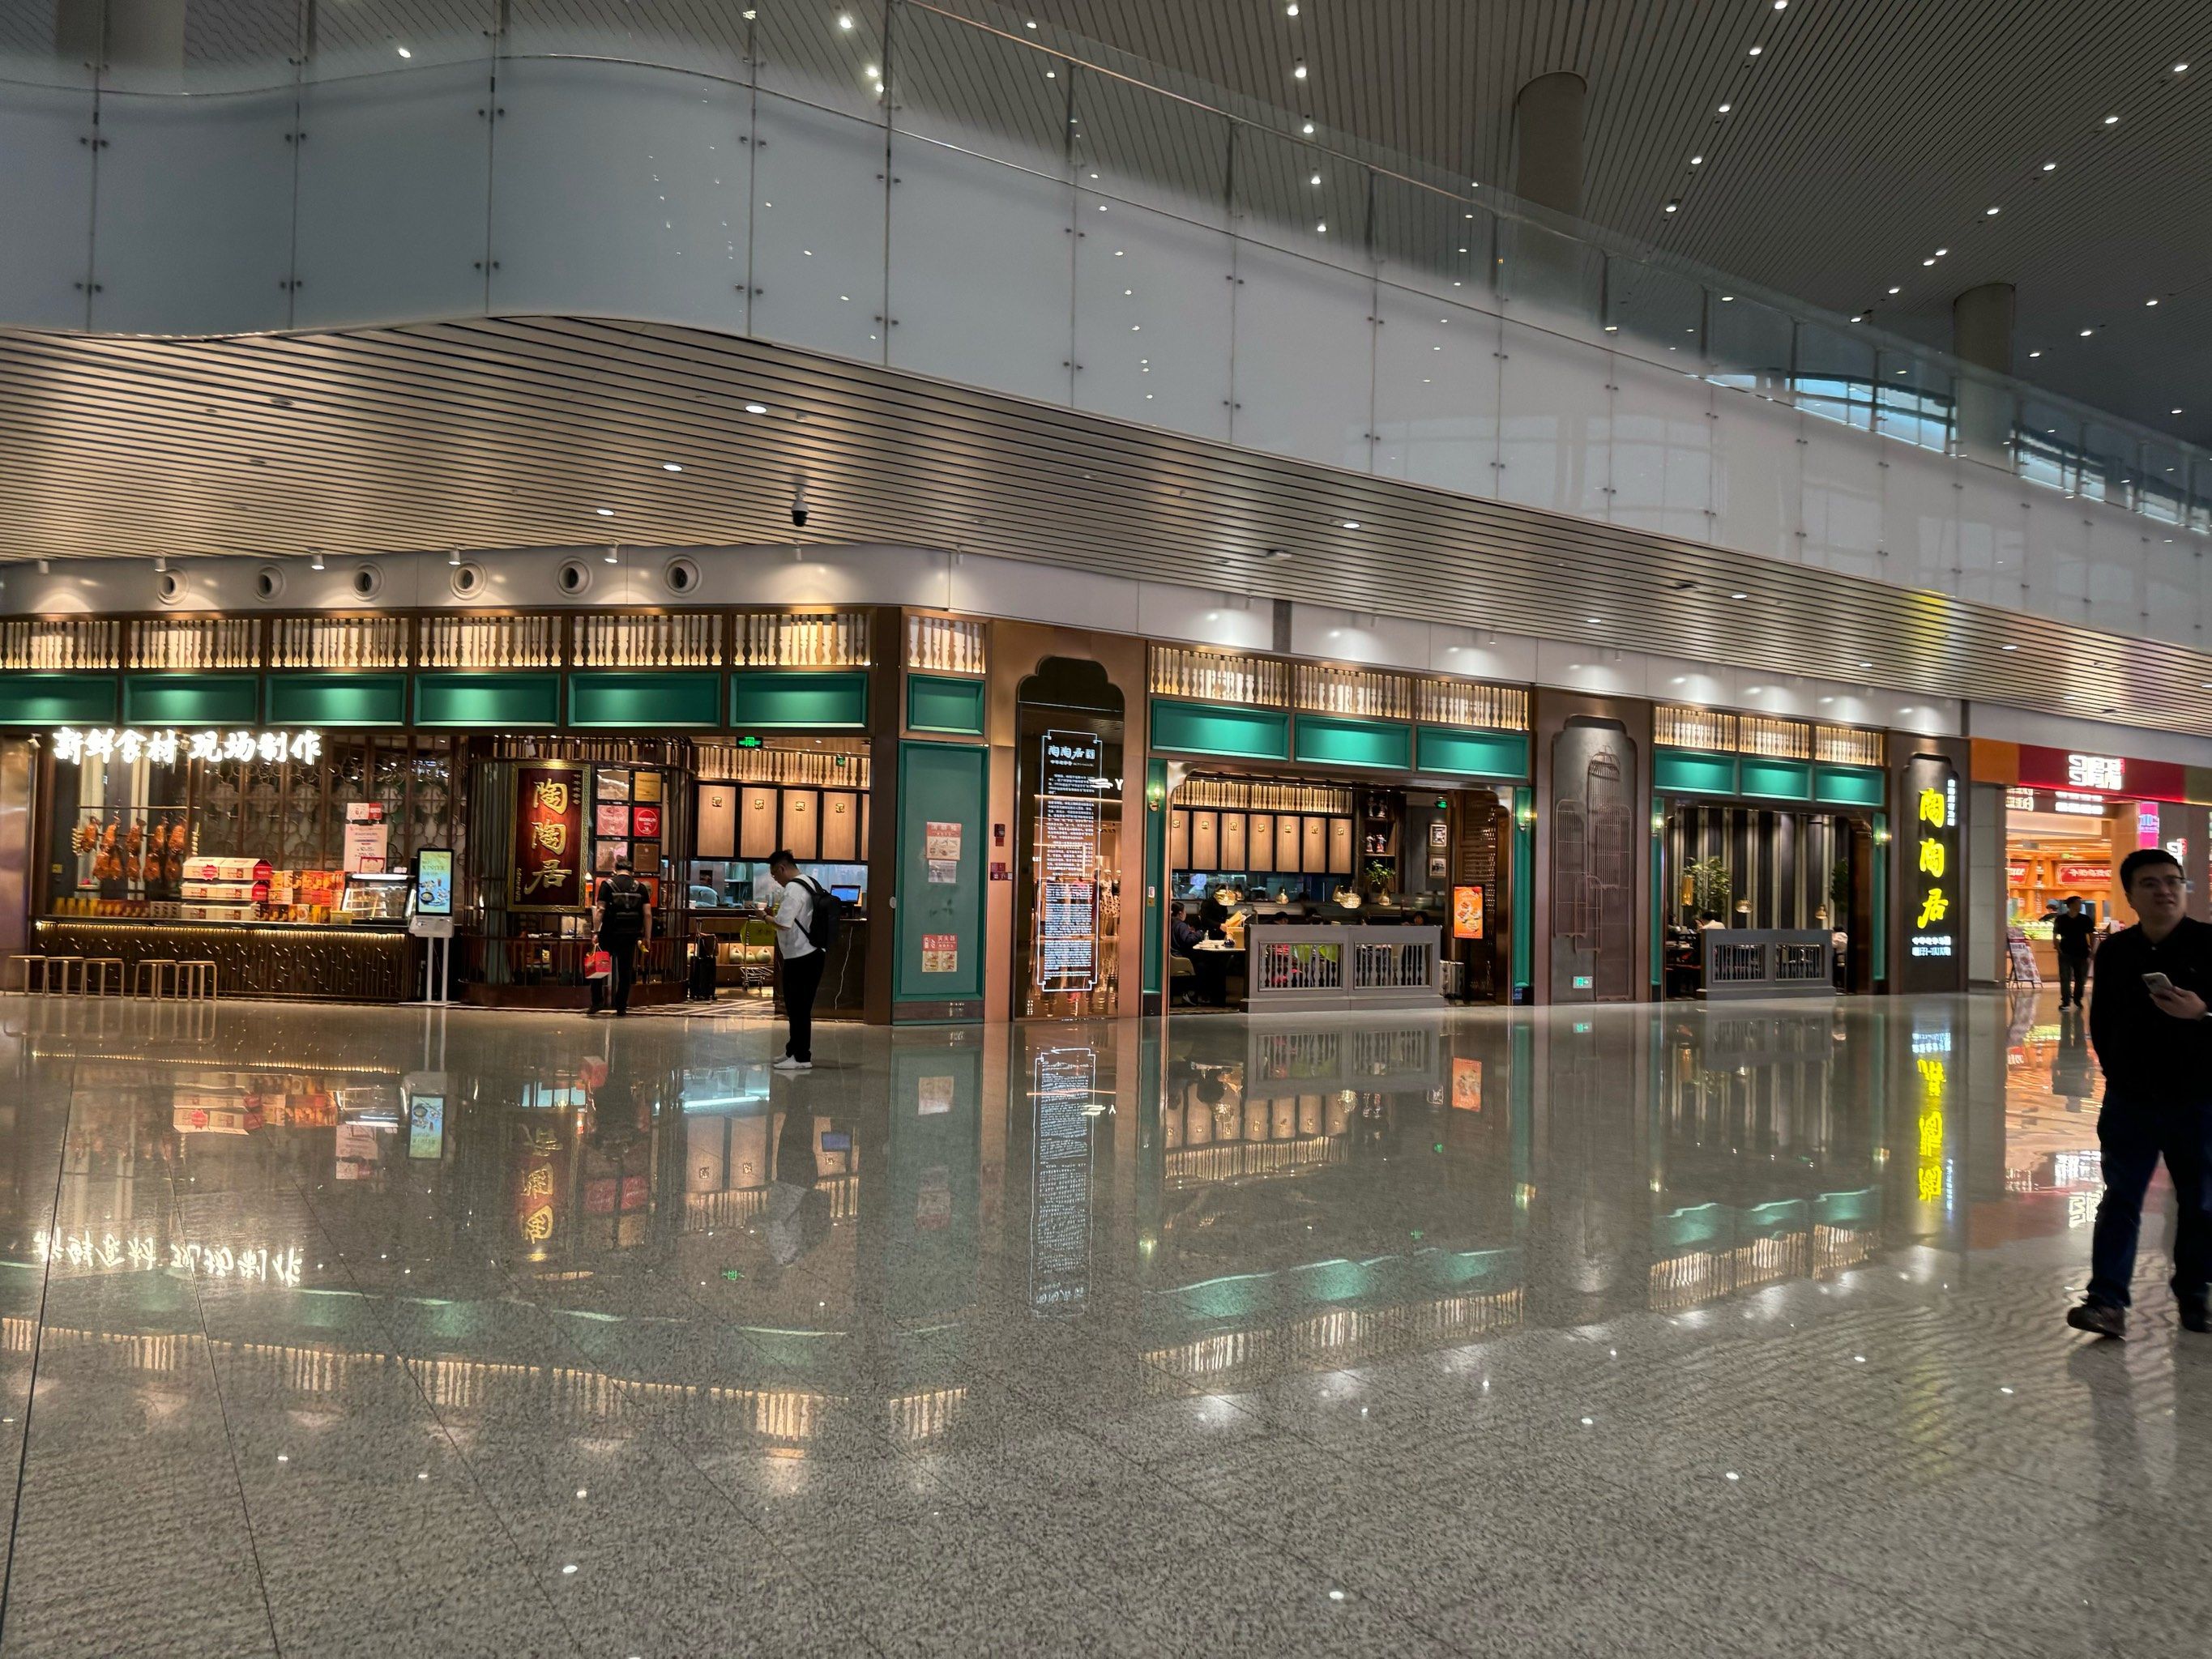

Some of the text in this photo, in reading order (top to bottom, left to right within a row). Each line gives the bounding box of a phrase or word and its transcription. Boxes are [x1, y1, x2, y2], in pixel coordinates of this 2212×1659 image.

[53, 727, 322, 765] 新鲜食材 现场制作
[1048, 745, 1084, 760] 陶陶居
[523, 778, 573, 895] 陶陶居
[1916, 787, 1949, 929] 陶陶居
